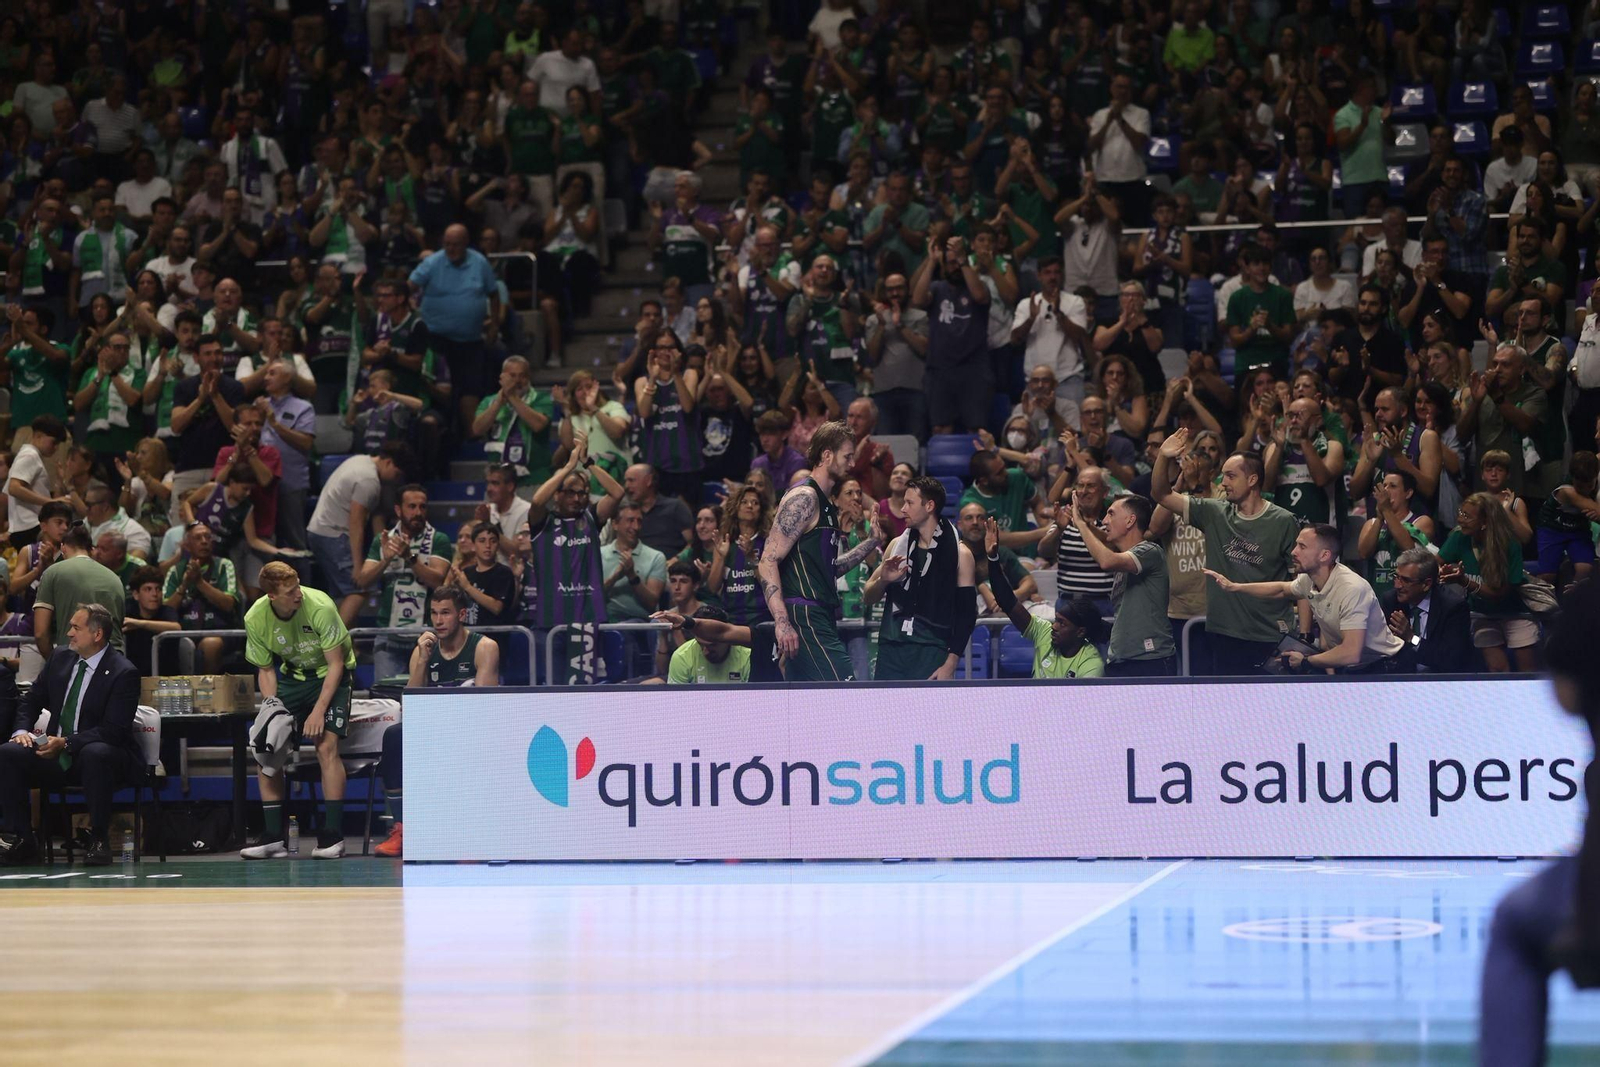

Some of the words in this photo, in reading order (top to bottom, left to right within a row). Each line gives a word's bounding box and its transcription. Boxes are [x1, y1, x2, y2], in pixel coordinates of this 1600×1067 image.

[1290, 487, 1303, 507] 9
[1176, 525, 1202, 539] COU
[1171, 541, 1196, 555] WIN
[1178, 556, 1206, 572] GAM
[731, 569, 756, 579] Unica
[597, 743, 1021, 828] quirónsalud
[1126, 748, 1193, 804] La
[1220, 742, 1399, 804] salud
[1428, 758, 1580, 817] pers
